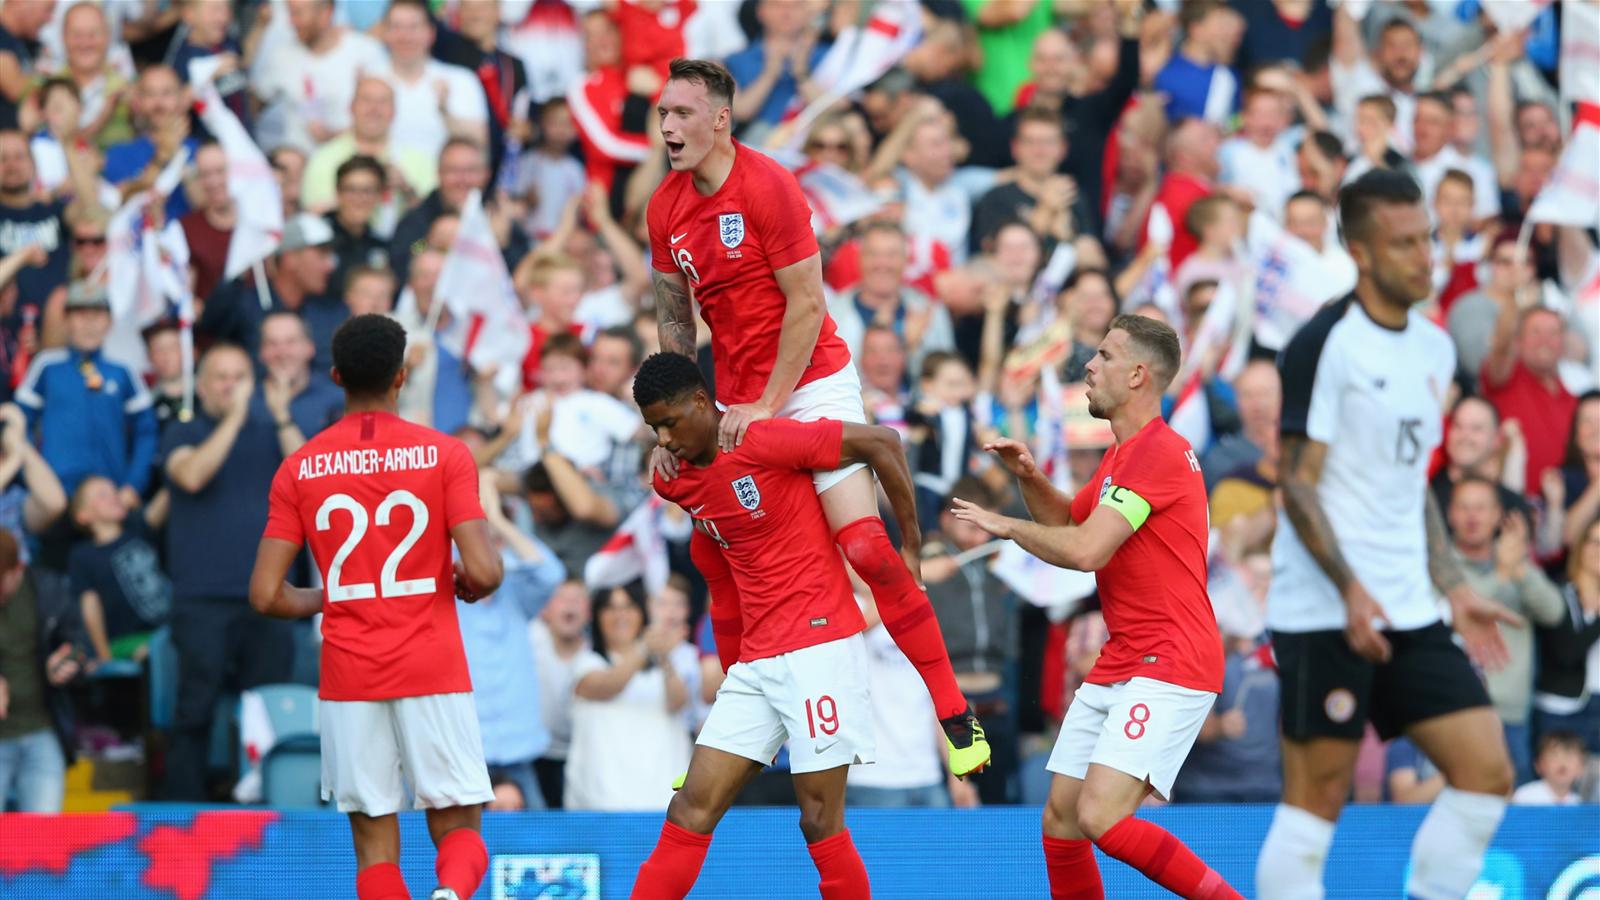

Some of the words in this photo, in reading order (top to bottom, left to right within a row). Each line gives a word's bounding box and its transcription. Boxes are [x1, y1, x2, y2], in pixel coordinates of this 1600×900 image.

[298, 445, 438, 480] ALEXANDER-ARNOLD
[1395, 419, 1421, 466] 15
[315, 489, 437, 602] 22
[805, 695, 839, 739] 19
[1124, 703, 1150, 740] 8
